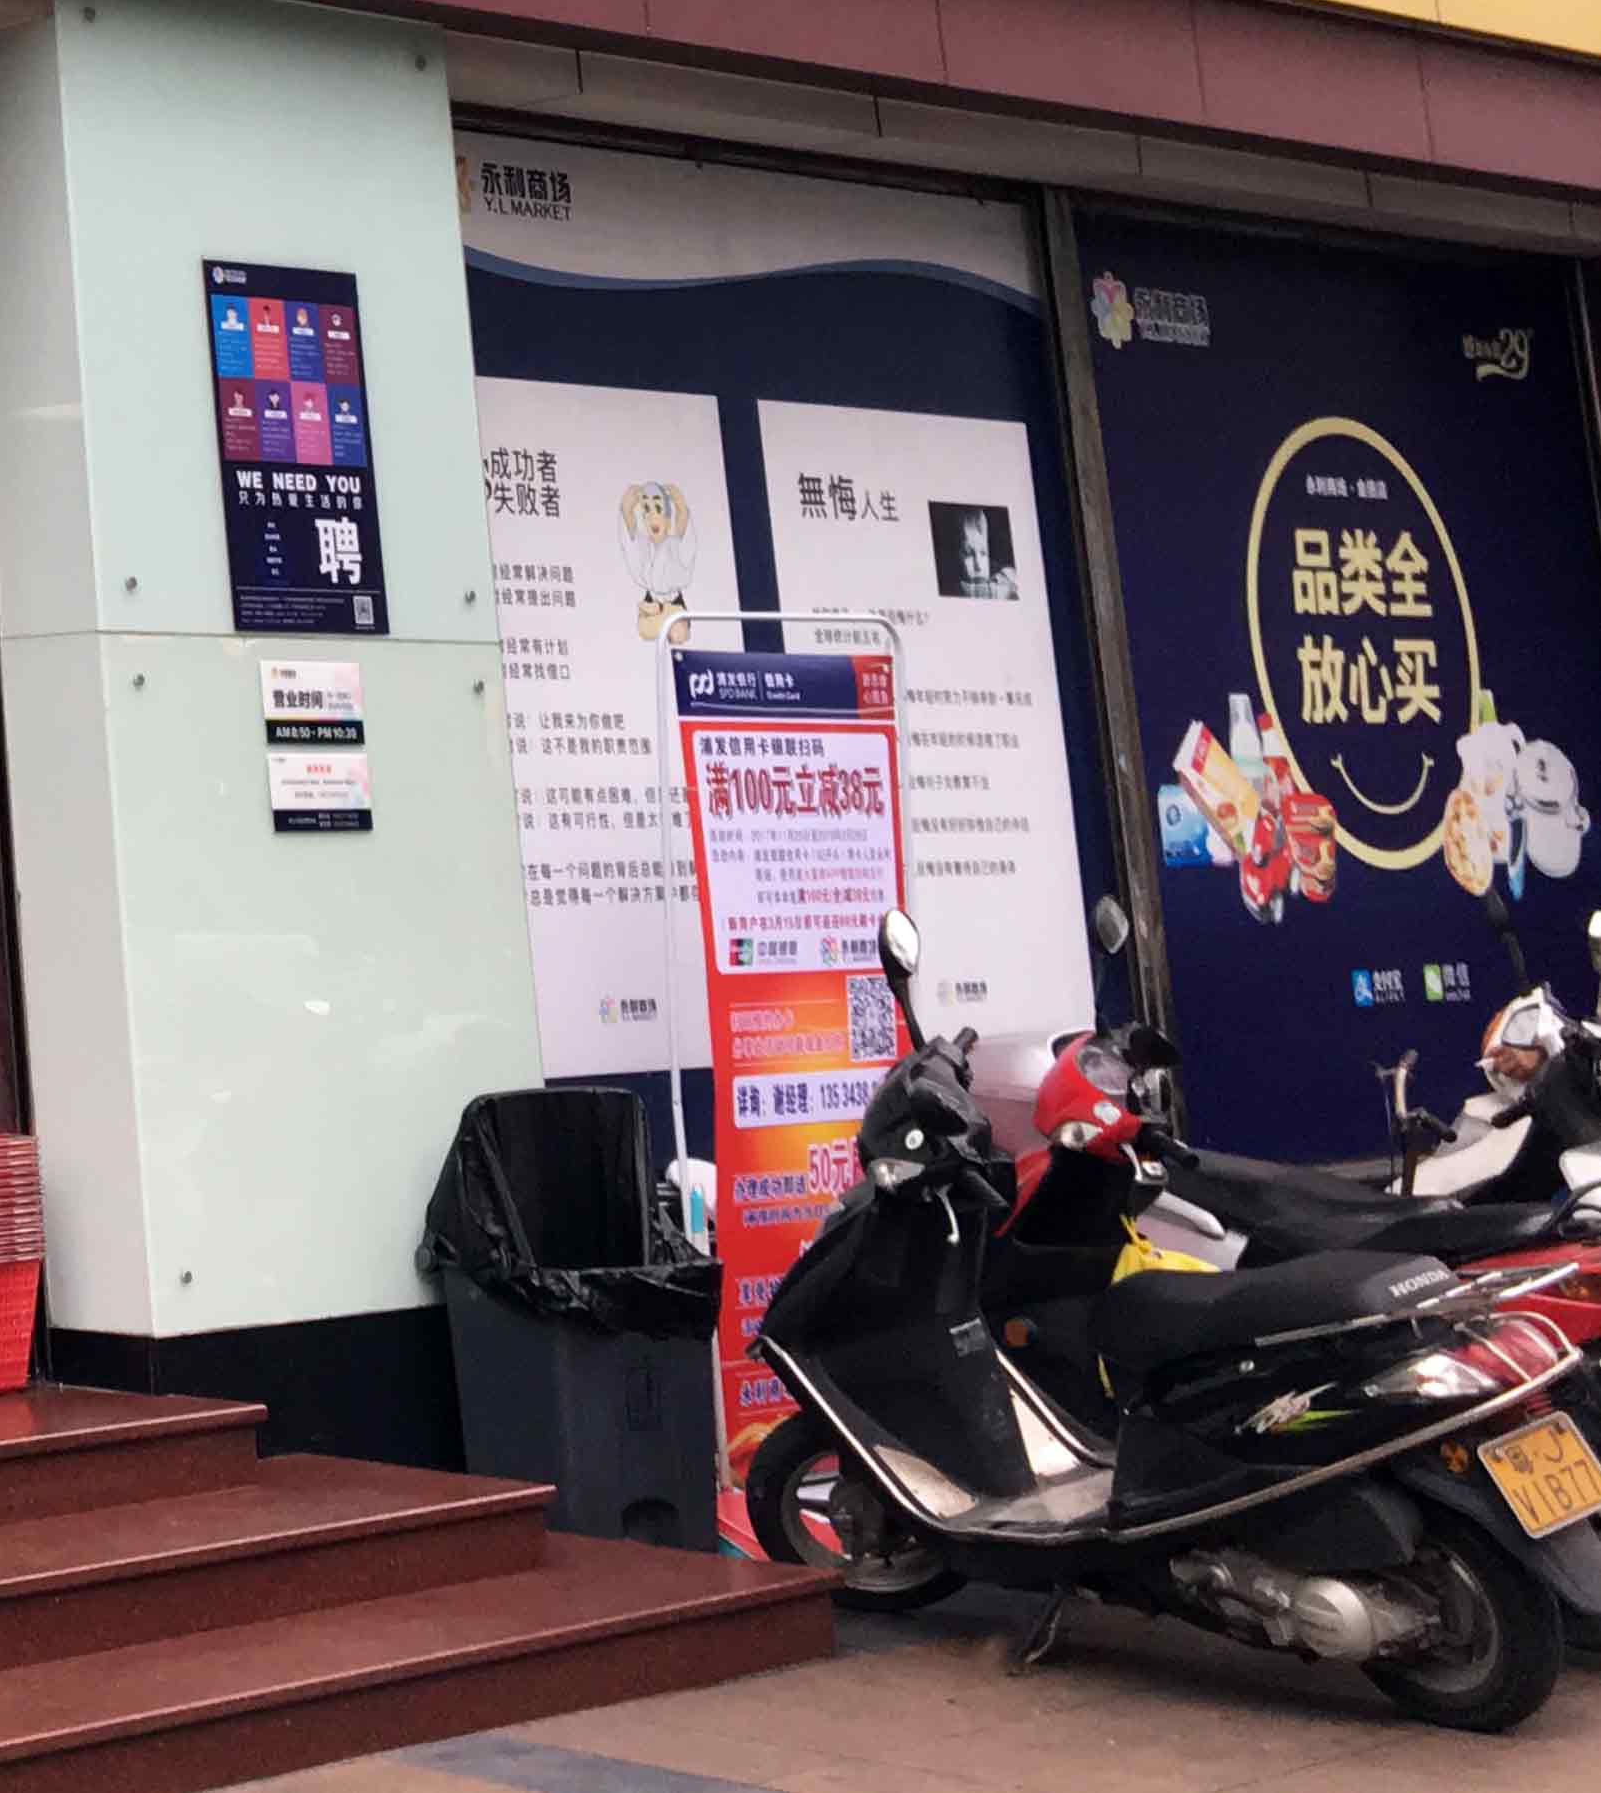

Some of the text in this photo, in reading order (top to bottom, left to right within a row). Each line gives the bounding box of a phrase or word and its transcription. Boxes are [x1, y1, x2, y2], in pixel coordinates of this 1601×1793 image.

[481, 162, 571, 204] 永利商场
[510, 198, 571, 221] MARKET
[236, 470, 361, 494] WE NEED YOU
[797, 472, 900, 522] 無悔人生
[314, 516, 362, 585] 聘
[493, 563, 574, 584] 经常解决问题
[1293, 528, 1433, 618] 品类全
[494, 588, 576, 608] 经常提出问题
[1298, 635, 1443, 725] 放心买
[705, 760, 886, 820] 满100元立减38元
[1388, 1269, 1450, 1298] HONDA
